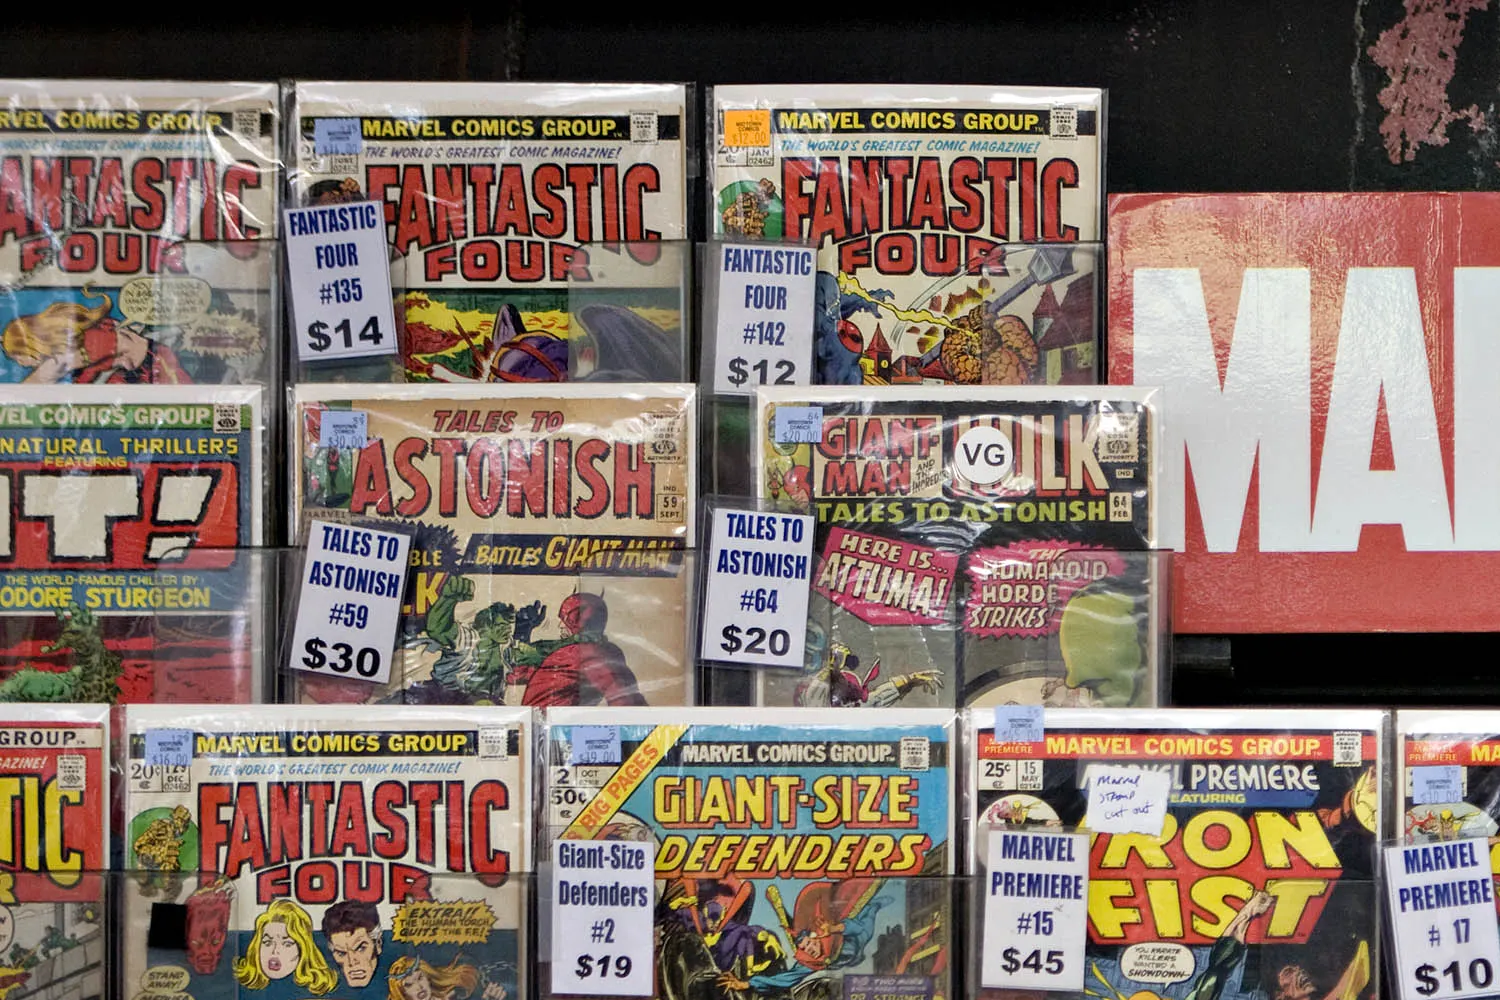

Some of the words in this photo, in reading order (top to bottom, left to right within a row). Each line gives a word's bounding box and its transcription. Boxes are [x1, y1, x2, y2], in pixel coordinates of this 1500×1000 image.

[363, 119, 446, 137] MARVEL
[452, 119, 535, 137] COMICS
[541, 120, 617, 138] GROUP
[365, 146, 387, 158] THE
[389, 146, 443, 158] WORLD'S
[446, 147, 502, 158] GREATEST
[509, 147, 548, 158] COMIC
[550, 147, 622, 159] MAGAZINE!
[365, 163, 662, 266] FANTASTIC
[780, 156, 1080, 249] FANTASTIC
[289, 204, 376, 236] FANTASTIC
[315, 244, 359, 269] FOUR
[424, 239, 594, 283] FOUR
[724, 248, 812, 275] FANTASTIC
[838, 232, 1010, 277] FOUR
[319, 278, 362, 305] #135
[745, 285, 787, 310] FOUR
[308, 315, 383, 352] $14
[743, 322, 785, 345] #142
[728, 357, 796, 386] $12
[433, 410, 514, 433] TALES
[531, 410, 565, 432] TO
[120, 438, 238, 455] THRILLERS
[962, 443, 1006, 466] VG
[45, 457, 127, 467] FEATURING
[350, 438, 656, 519] ASTONISH
[663, 496, 678, 509] 59
[816, 502, 903, 522] TALES
[914, 502, 948, 522] TO
[958, 501, 1106, 521] ASTONISH
[726, 513, 776, 541] TALES
[782, 517, 804, 541] TO
[322, 525, 371, 558] TALES
[377, 535, 399, 561] TO
[840, 533, 902, 563] HERE
[717, 550, 807, 580] ASTONISH
[309, 561, 400, 598] ASTONISH
[818, 552, 947, 617] ATTUMA!
[86, 588, 210, 608] STURGEON
[740, 589, 778, 613] #64
[329, 603, 368, 629] #59
[720, 625, 791, 656] $20
[302, 637, 381, 677] $30
[1191, 764, 1320, 790] PREMIERE
[653, 774, 920, 829] GIANT-SIZE
[198, 780, 511, 888] FANTASTIC
[559, 844, 644, 870] Giant-Size
[655, 834, 932, 879] DEFENDERS
[1002, 836, 1075, 862] MARVEL
[1404, 842, 1478, 874] MARVEL
[256, 860, 434, 905] FOUR
[559, 881, 648, 907] Defenders
[991, 875, 1083, 899] PREMIERE
[1399, 879, 1492, 912] PREMIERE
[410, 908, 476, 918] EXTRA!!
[1089, 876, 1330, 938] FIST
[592, 920, 615, 944] #2
[1017, 912, 1053, 935] #15
[575, 955, 632, 979] $19
[1002, 948, 1064, 974] $45
[1415, 958, 1492, 996] $10
